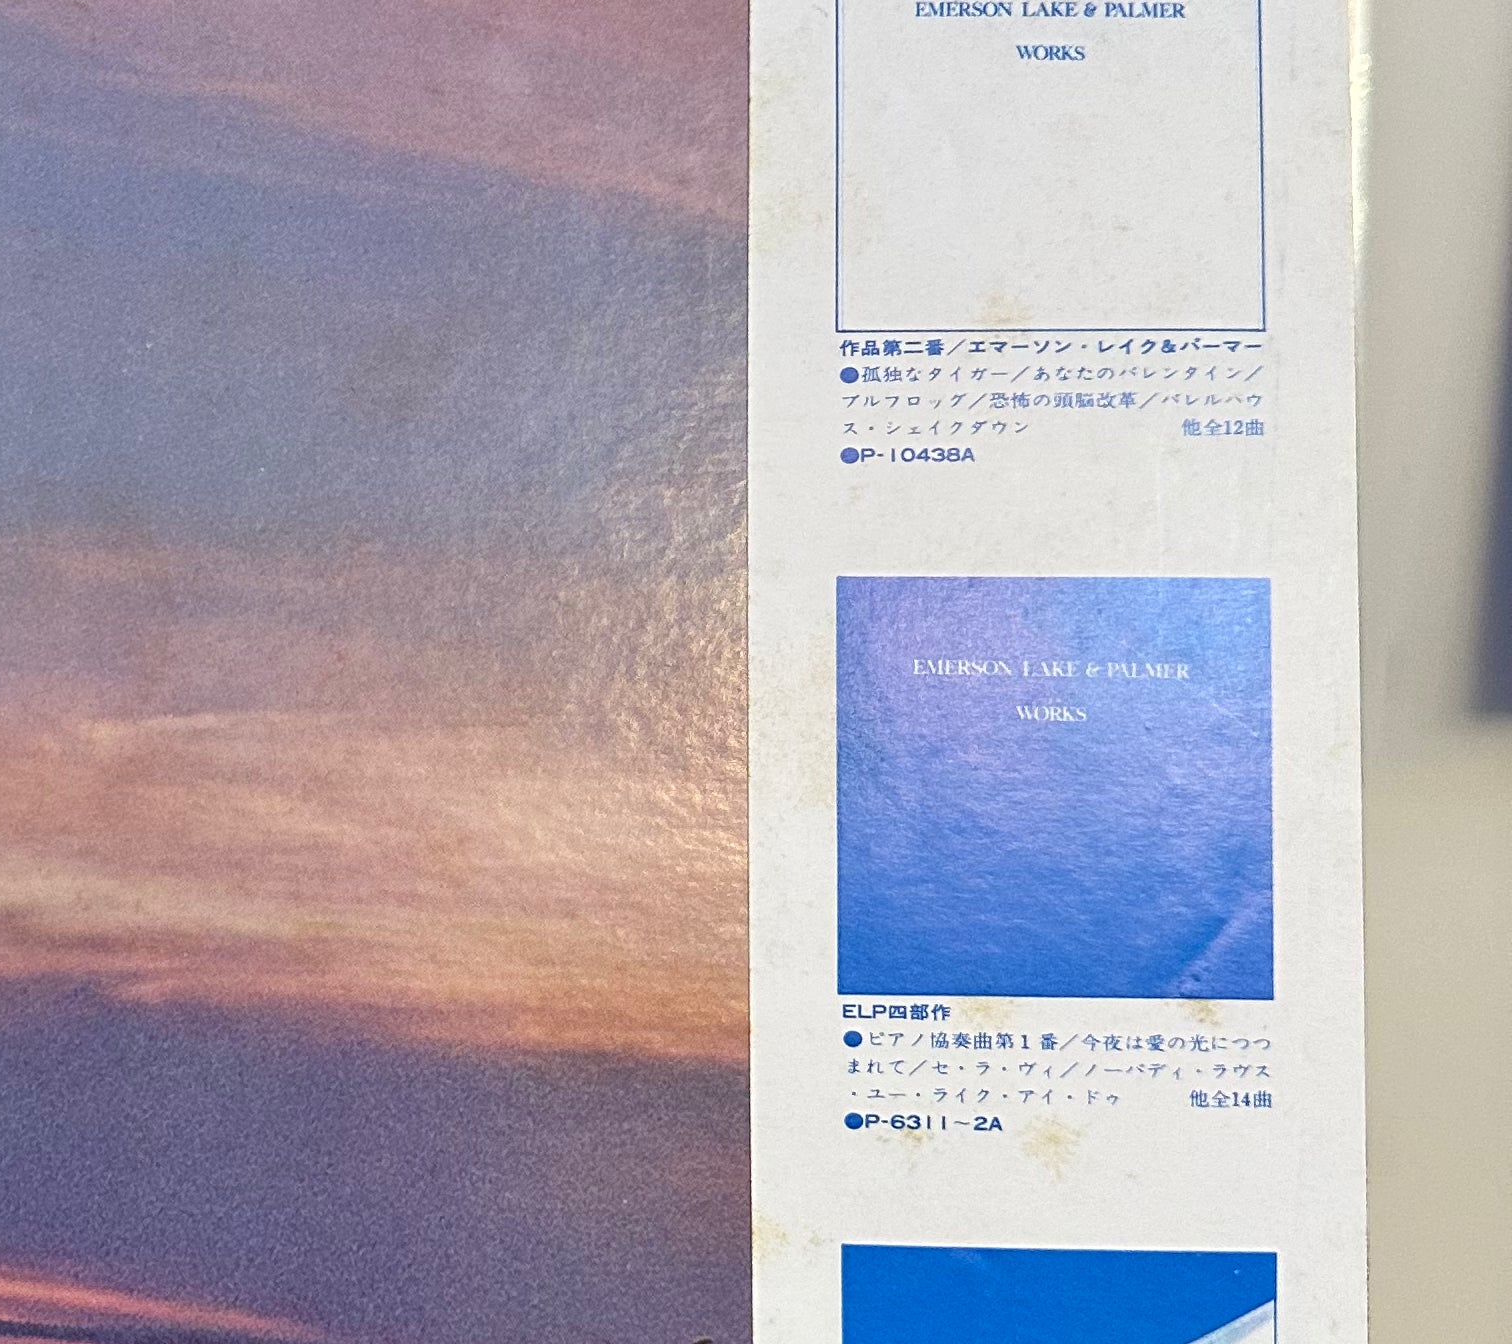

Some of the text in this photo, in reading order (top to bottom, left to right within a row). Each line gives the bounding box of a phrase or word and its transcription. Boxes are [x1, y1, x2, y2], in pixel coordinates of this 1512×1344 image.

[915, 1, 1185, 19] EMERSON LAKE & PALMER
[1016, 45, 1086, 62] WORKS
[913, 659, 1189, 679] EMERSON LAKE & PALMER
[1016, 705, 1087, 722] WORKS
[842, 1004, 951, 1020] ELP四部作
[1190, 1089, 1272, 1108] 他全14曲
